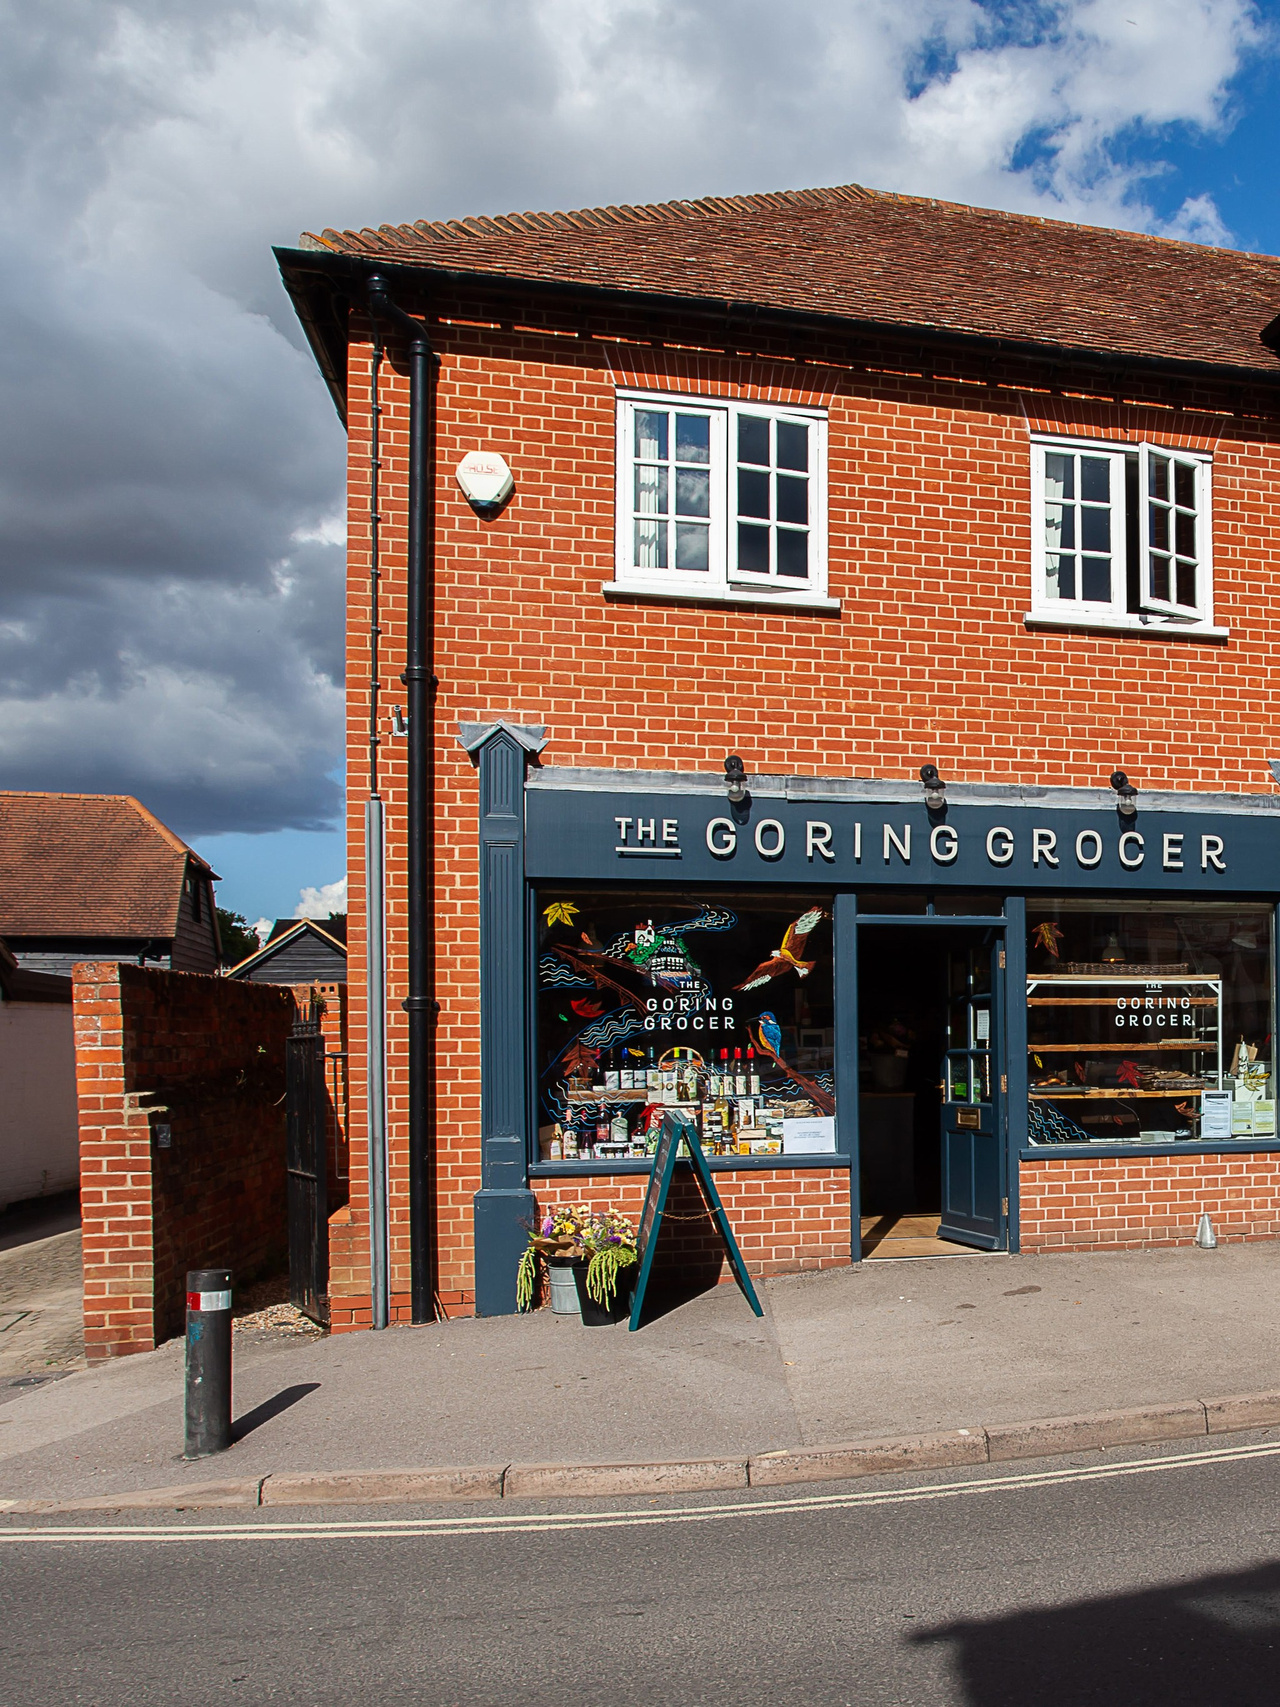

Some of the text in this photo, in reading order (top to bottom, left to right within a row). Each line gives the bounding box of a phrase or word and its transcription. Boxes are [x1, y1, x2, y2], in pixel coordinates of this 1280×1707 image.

[614, 816, 1228, 869] THE GORING GROCER
[679, 981, 700, 989] THE
[646, 998, 733, 1011] GORING
[1116, 997, 1190, 1010] GORING
[643, 1016, 736, 1031] GROCER
[1114, 1014, 1192, 1027] GROCER
